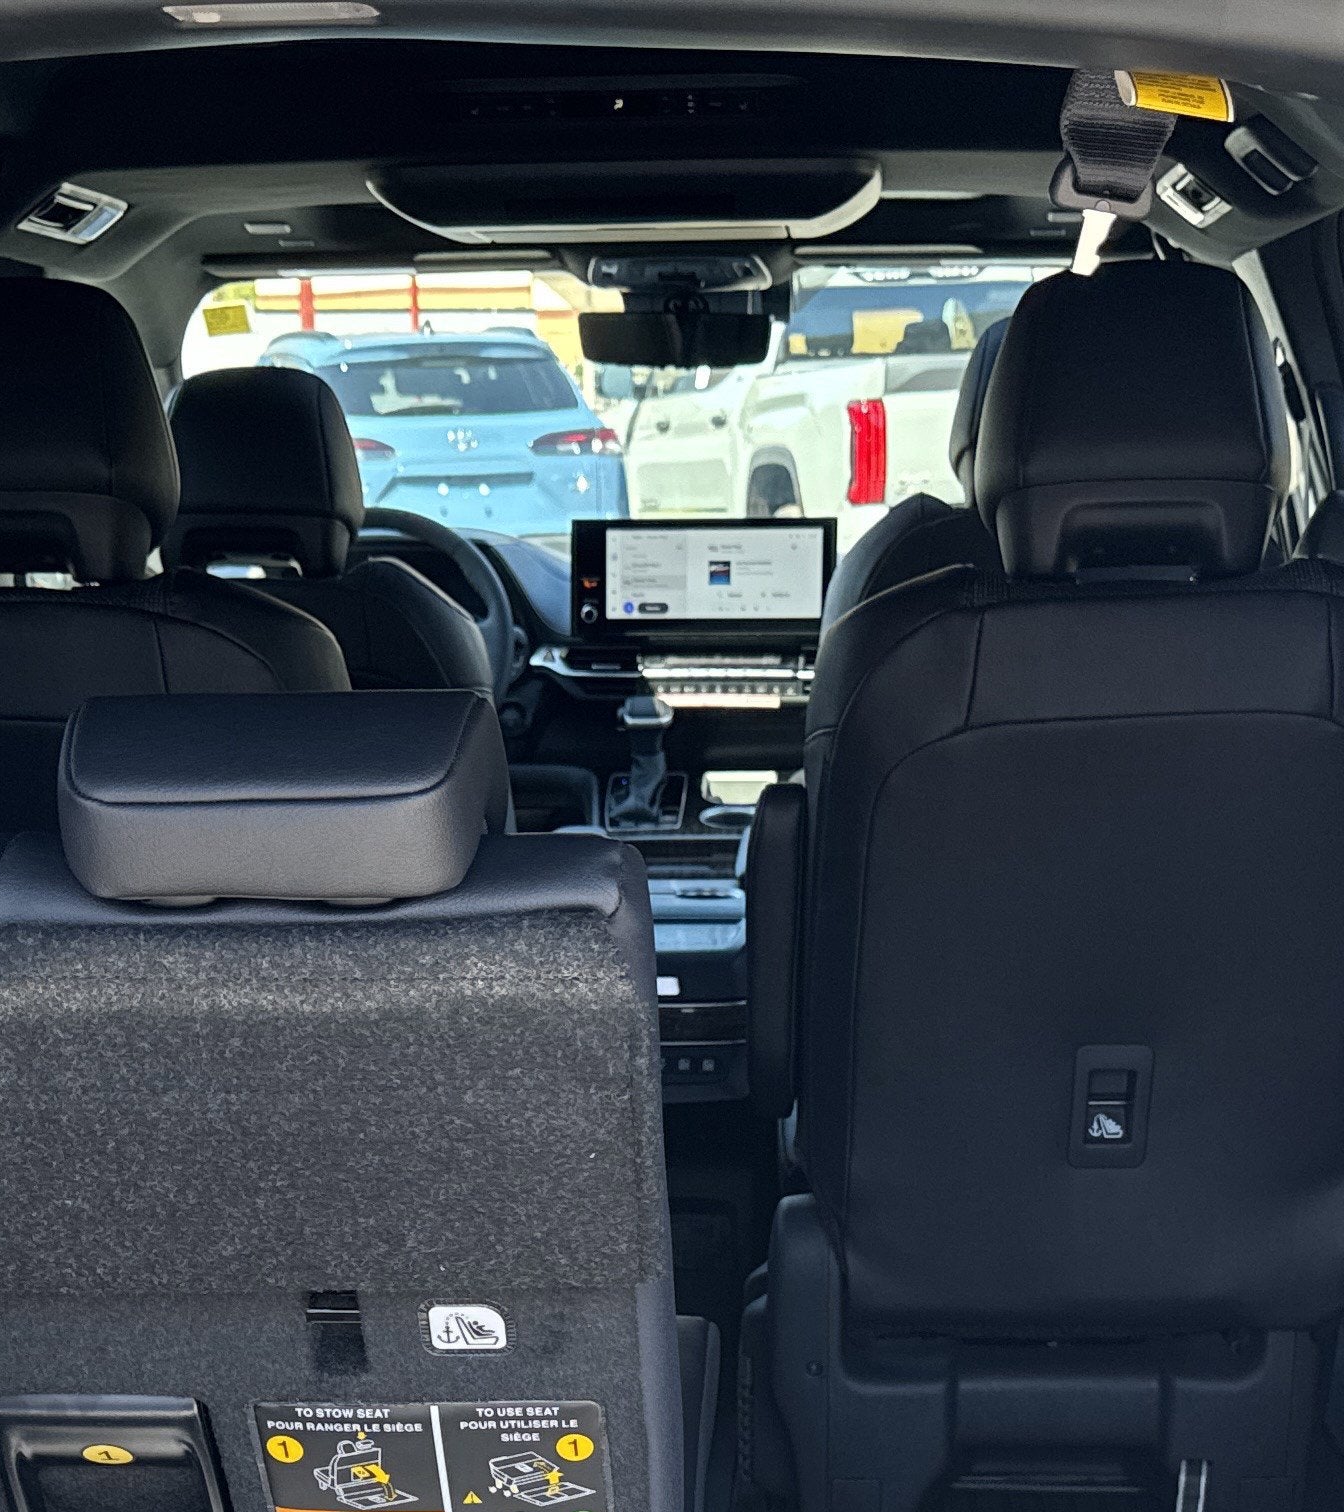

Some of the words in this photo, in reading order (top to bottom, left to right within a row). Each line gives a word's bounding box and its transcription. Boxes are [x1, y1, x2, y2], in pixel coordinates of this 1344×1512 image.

[294, 1407, 313, 1417] TO
[316, 1408, 353, 1419] STOW
[357, 1408, 391, 1419] SEAT
[476, 1407, 494, 1417] TO
[497, 1407, 523, 1417] USE
[526, 1407, 560, 1416] SEAT
[267, 1420, 304, 1430] POUR
[306, 1422, 361, 1432] RANGER
[363, 1423, 381, 1432] LE
[459, 1420, 497, 1430] POUR
[499, 1419, 559, 1429] UTILISER
[562, 1419, 578, 1428] LE
[277, 1440, 290, 1459] 1
[567, 1438, 579, 1457] 1
